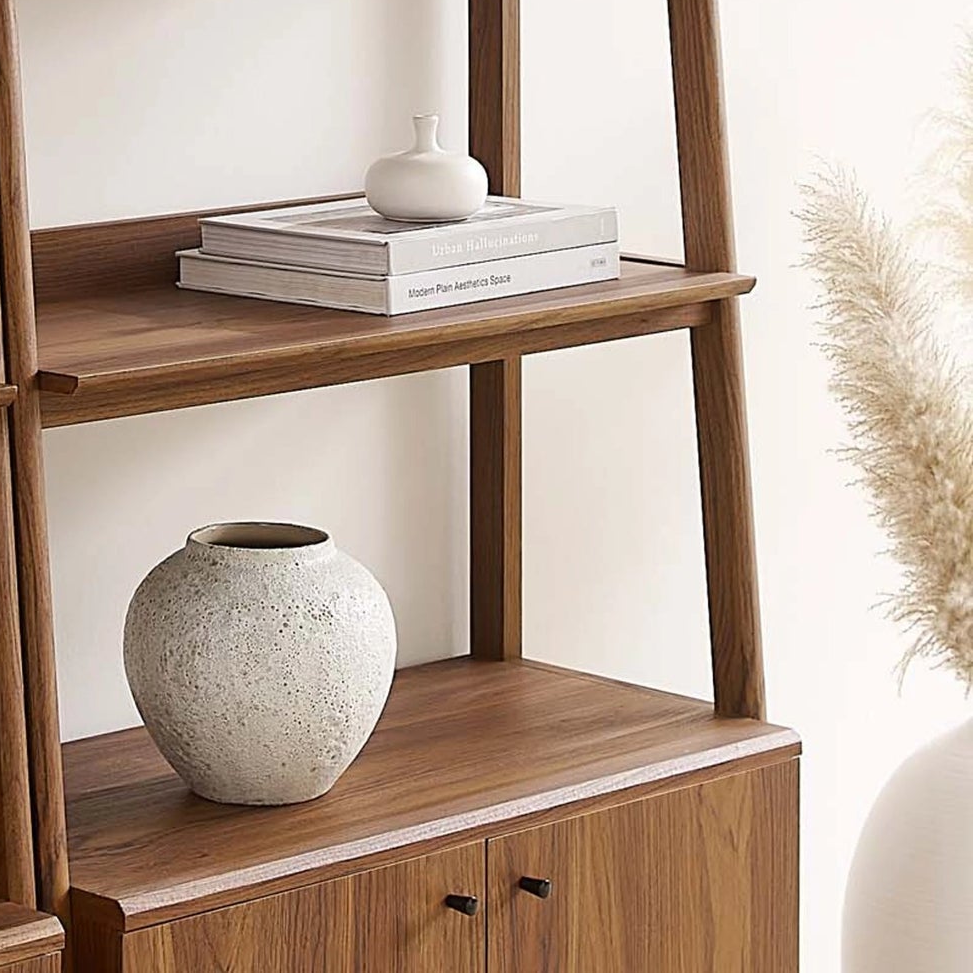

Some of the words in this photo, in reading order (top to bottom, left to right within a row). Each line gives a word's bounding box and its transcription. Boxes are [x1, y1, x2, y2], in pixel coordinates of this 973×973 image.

[432, 243, 462, 256] Urban
[466, 233, 539, 252] Hallucinations
[408, 285, 435, 298] Modern
[436, 282, 453, 294] Plain
[454, 277, 489, 291] Aesthetics
[490, 273, 511, 286] Space
